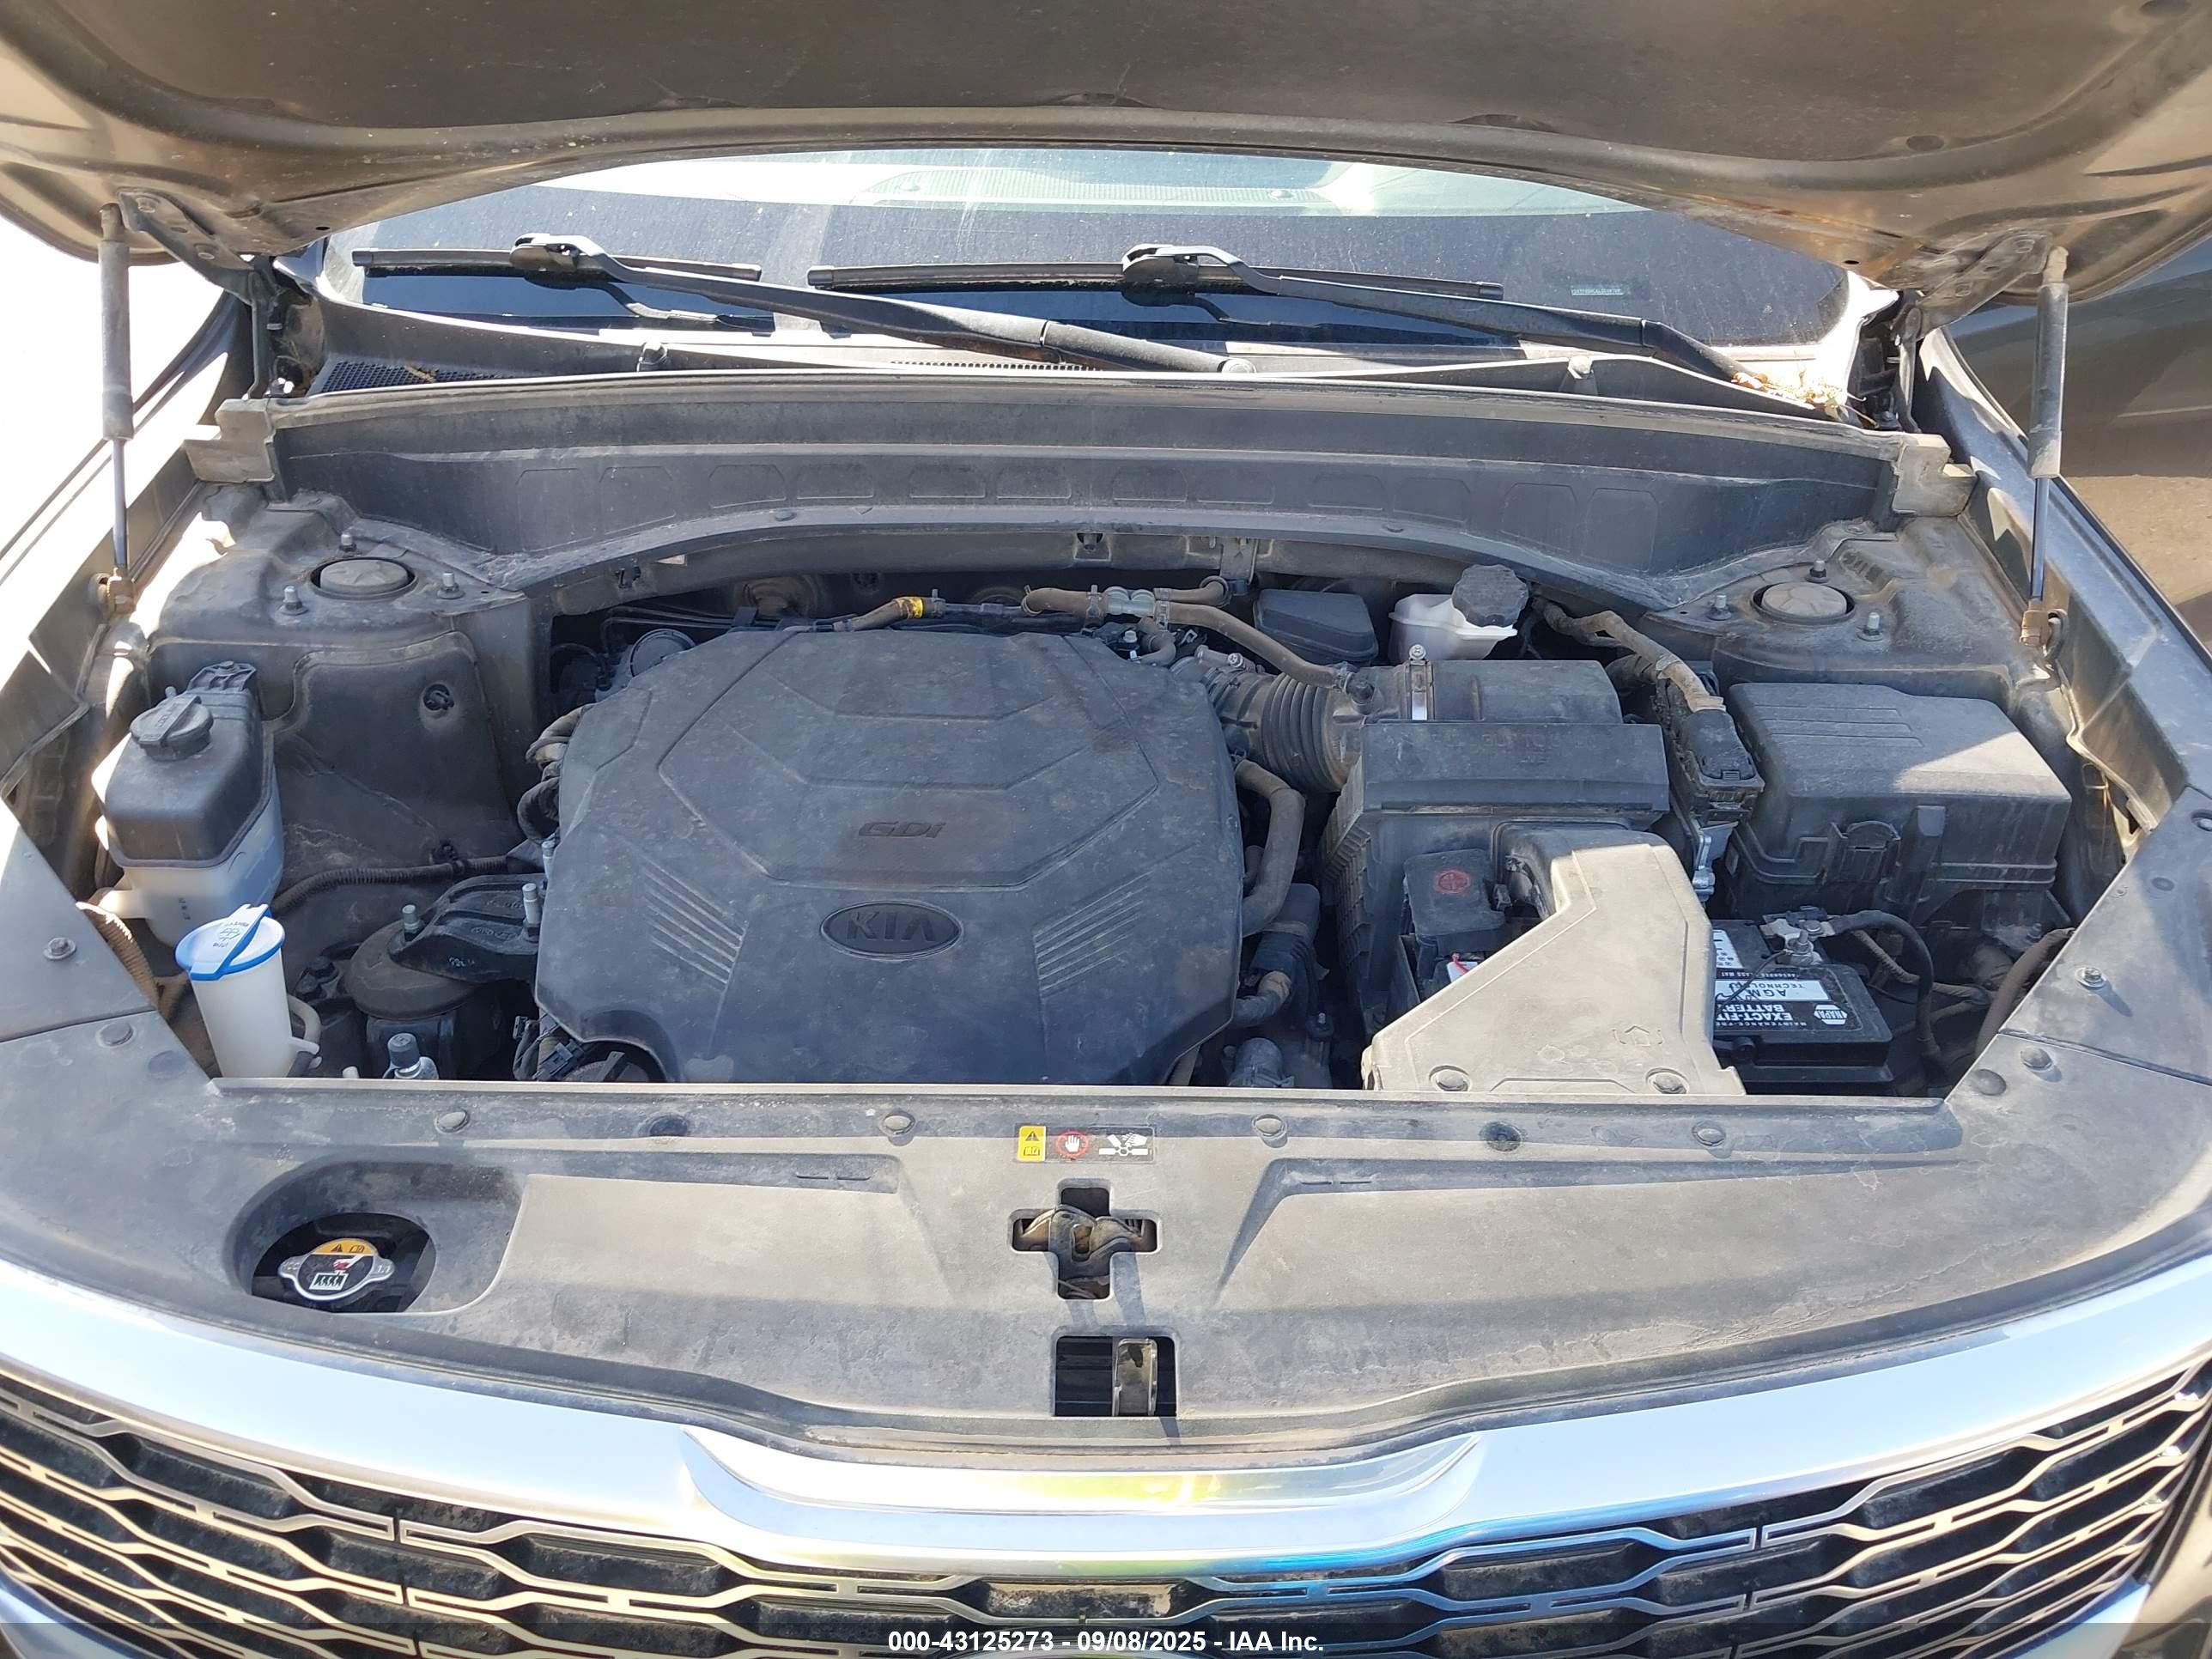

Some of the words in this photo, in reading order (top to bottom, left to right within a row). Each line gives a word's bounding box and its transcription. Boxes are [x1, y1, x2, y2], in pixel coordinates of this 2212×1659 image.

[846, 910, 935, 942] KIA
[1748, 989, 1787, 998] AGM
[1716, 1012, 1793, 1021] EXACT-FIT
